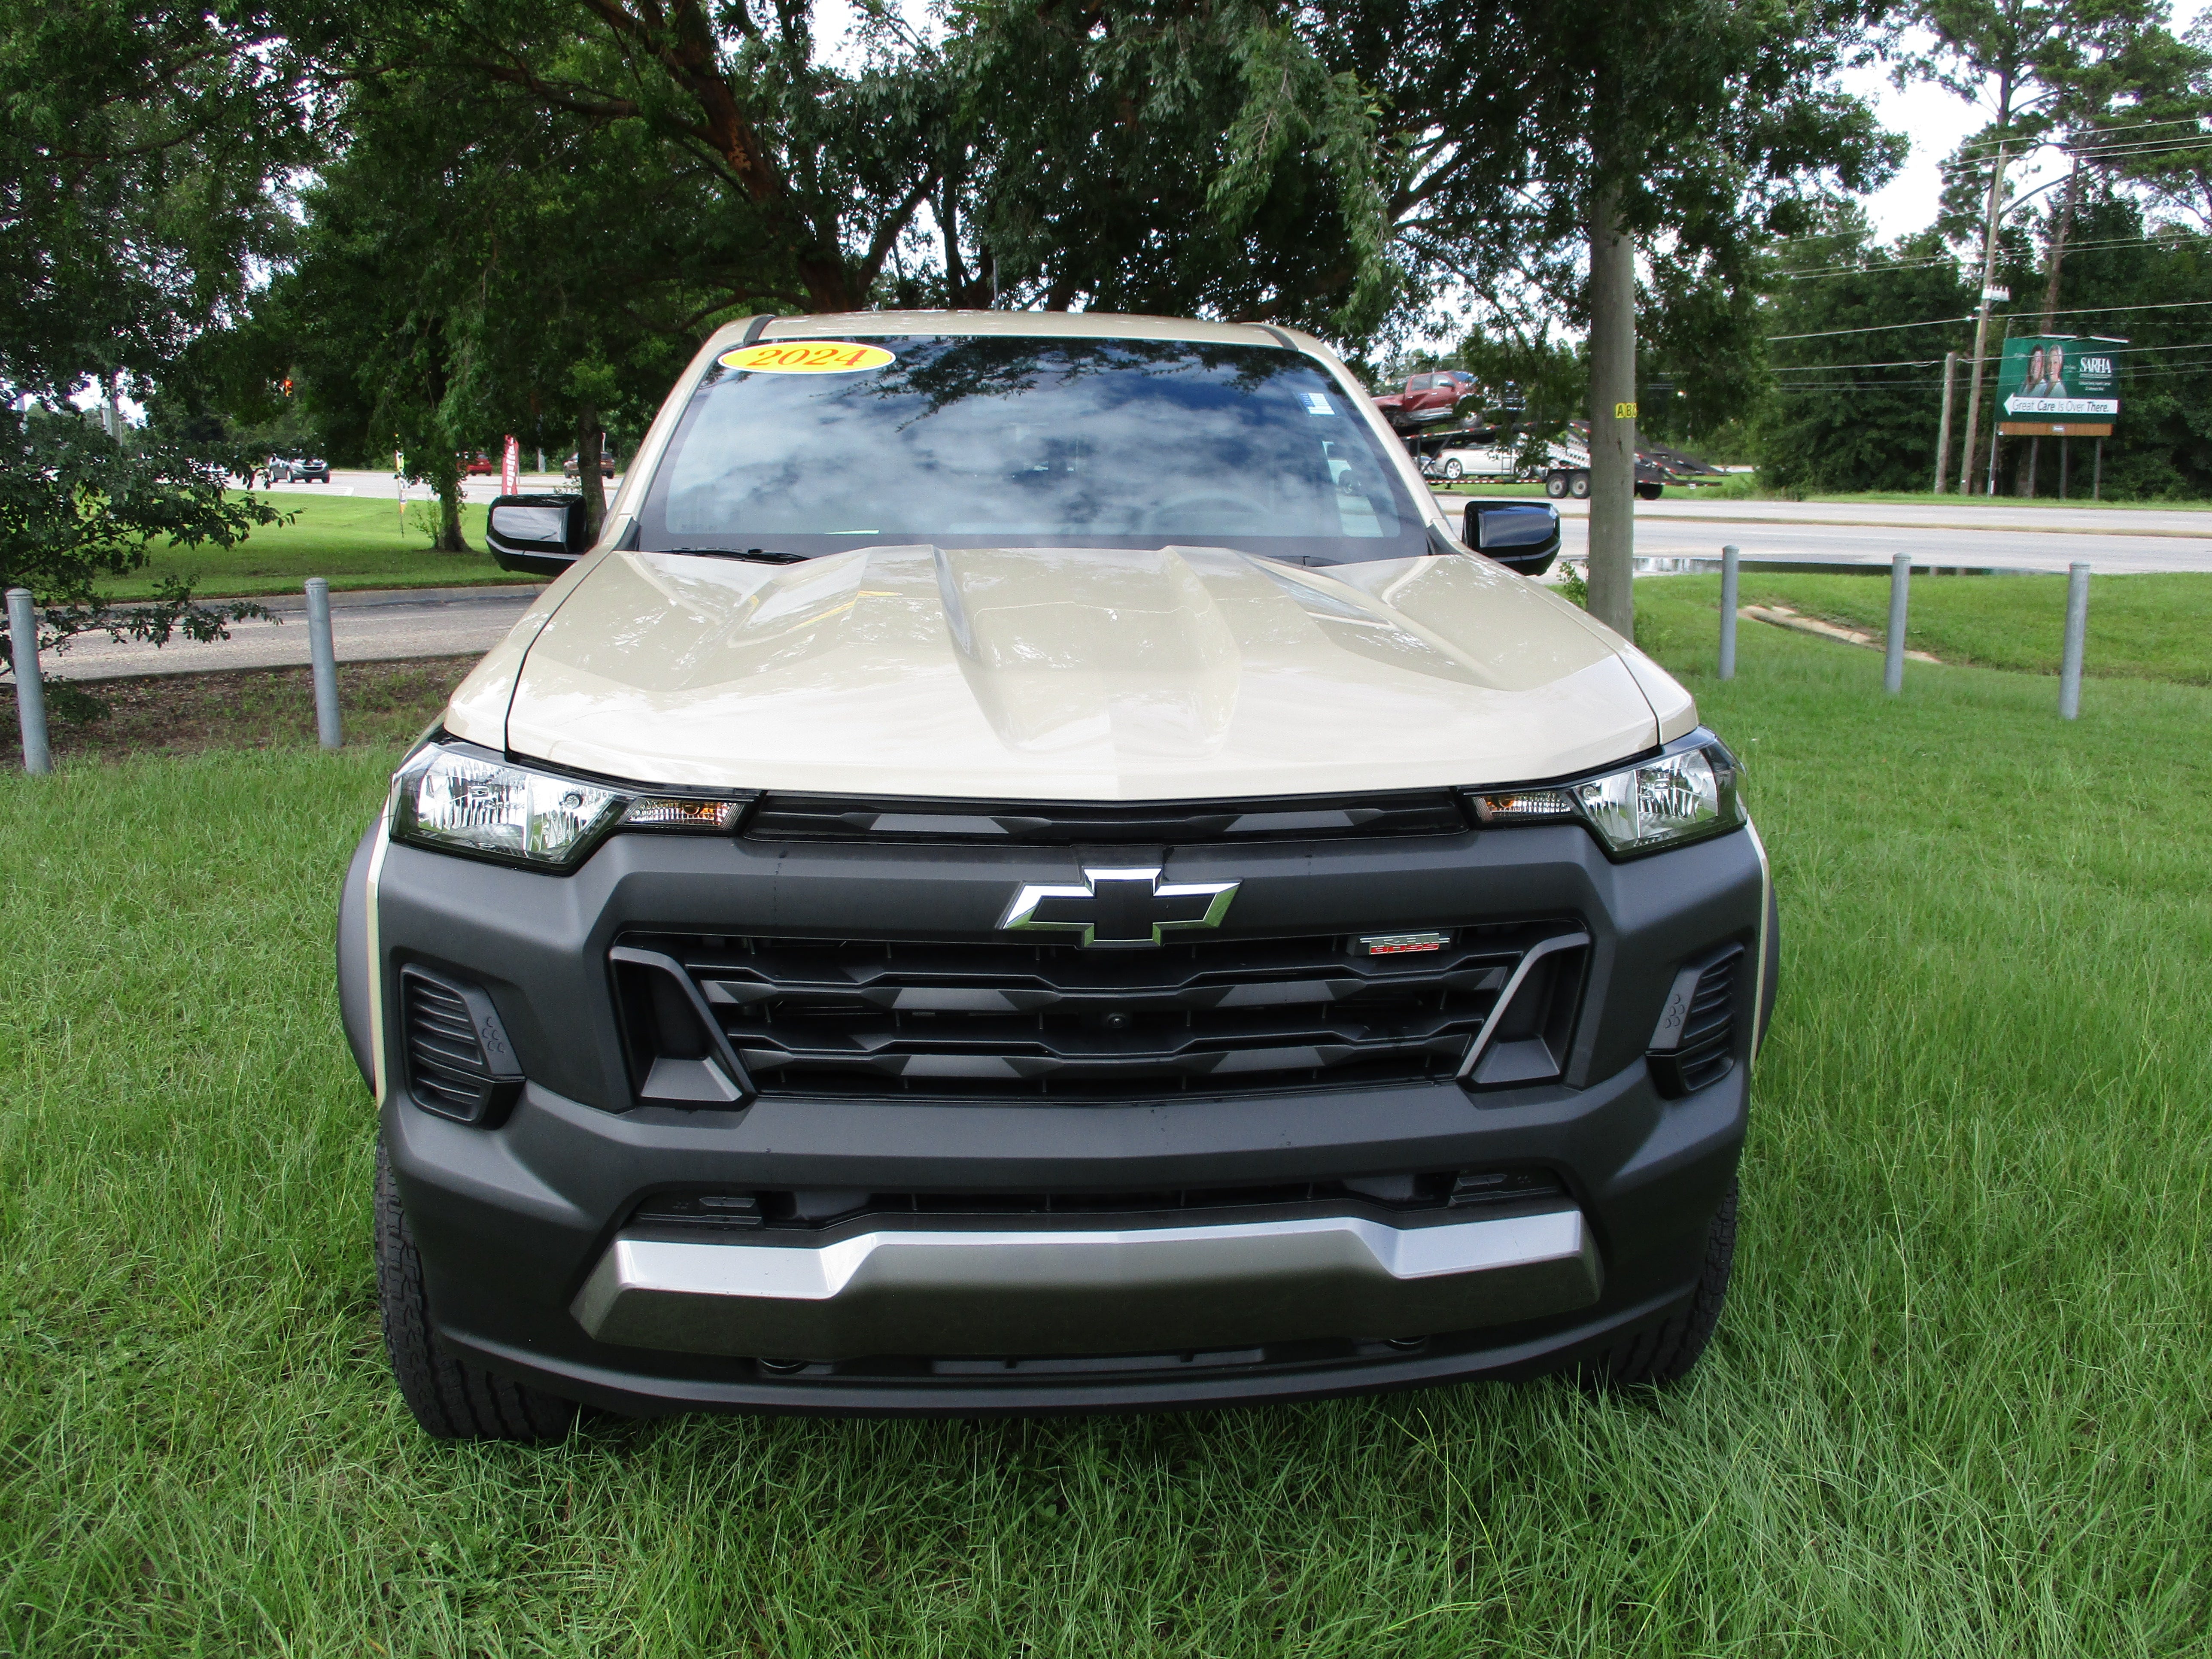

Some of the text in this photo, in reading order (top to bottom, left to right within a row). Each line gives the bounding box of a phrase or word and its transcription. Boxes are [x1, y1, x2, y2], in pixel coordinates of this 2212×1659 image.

[746, 349, 868, 366] 2024
[2080, 357, 2112, 373] SARHA
[2012, 399, 2109, 412] Great Care Is Over There.
[1359, 933, 1450, 948] TRAIL
[1370, 943, 1439, 955] BOSS
